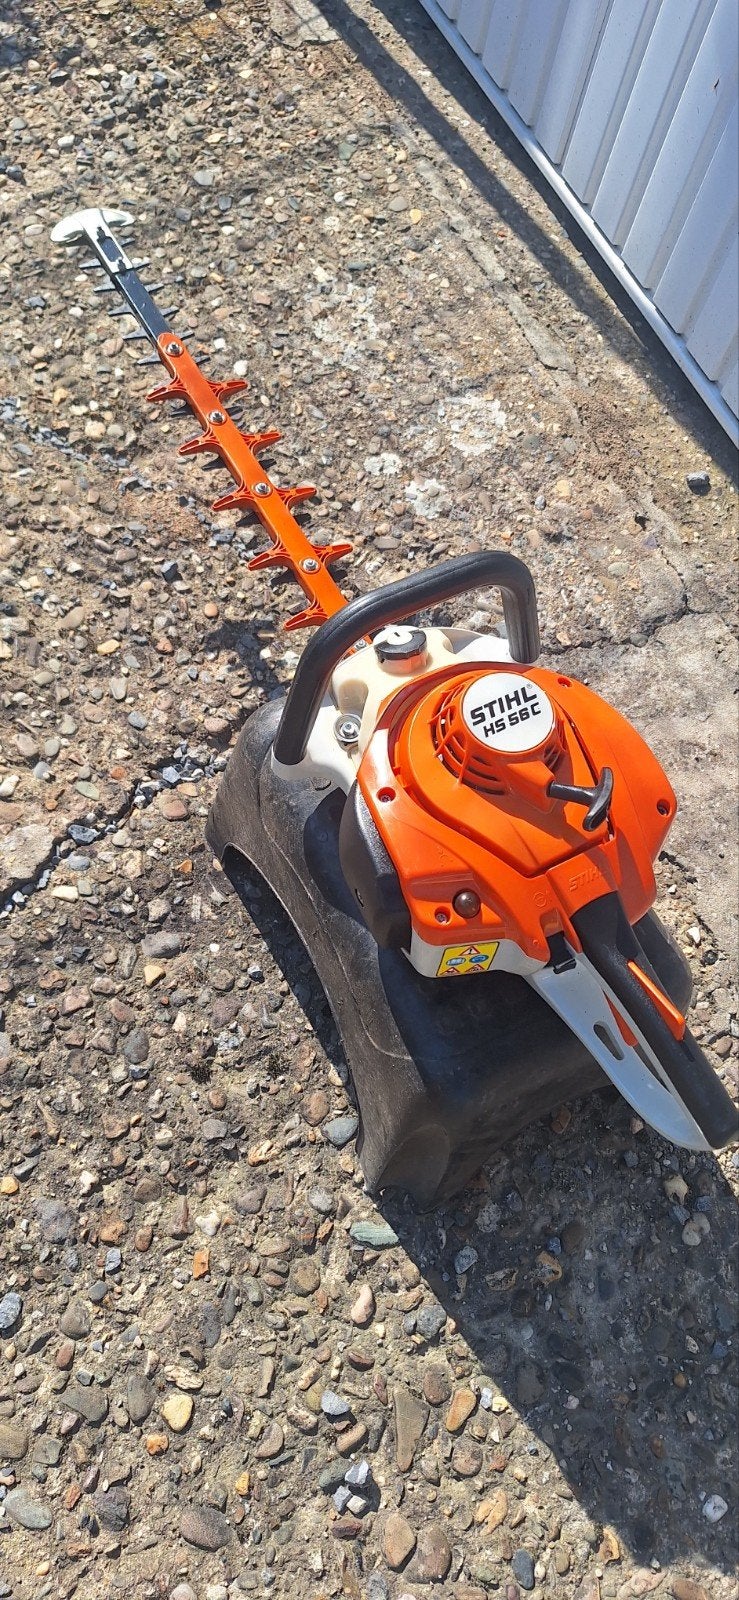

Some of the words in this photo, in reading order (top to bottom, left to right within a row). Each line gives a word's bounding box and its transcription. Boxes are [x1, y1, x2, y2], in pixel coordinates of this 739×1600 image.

[483, 718, 506, 738] HS
[507, 707, 530, 726] 56
[531, 702, 541, 716] C
